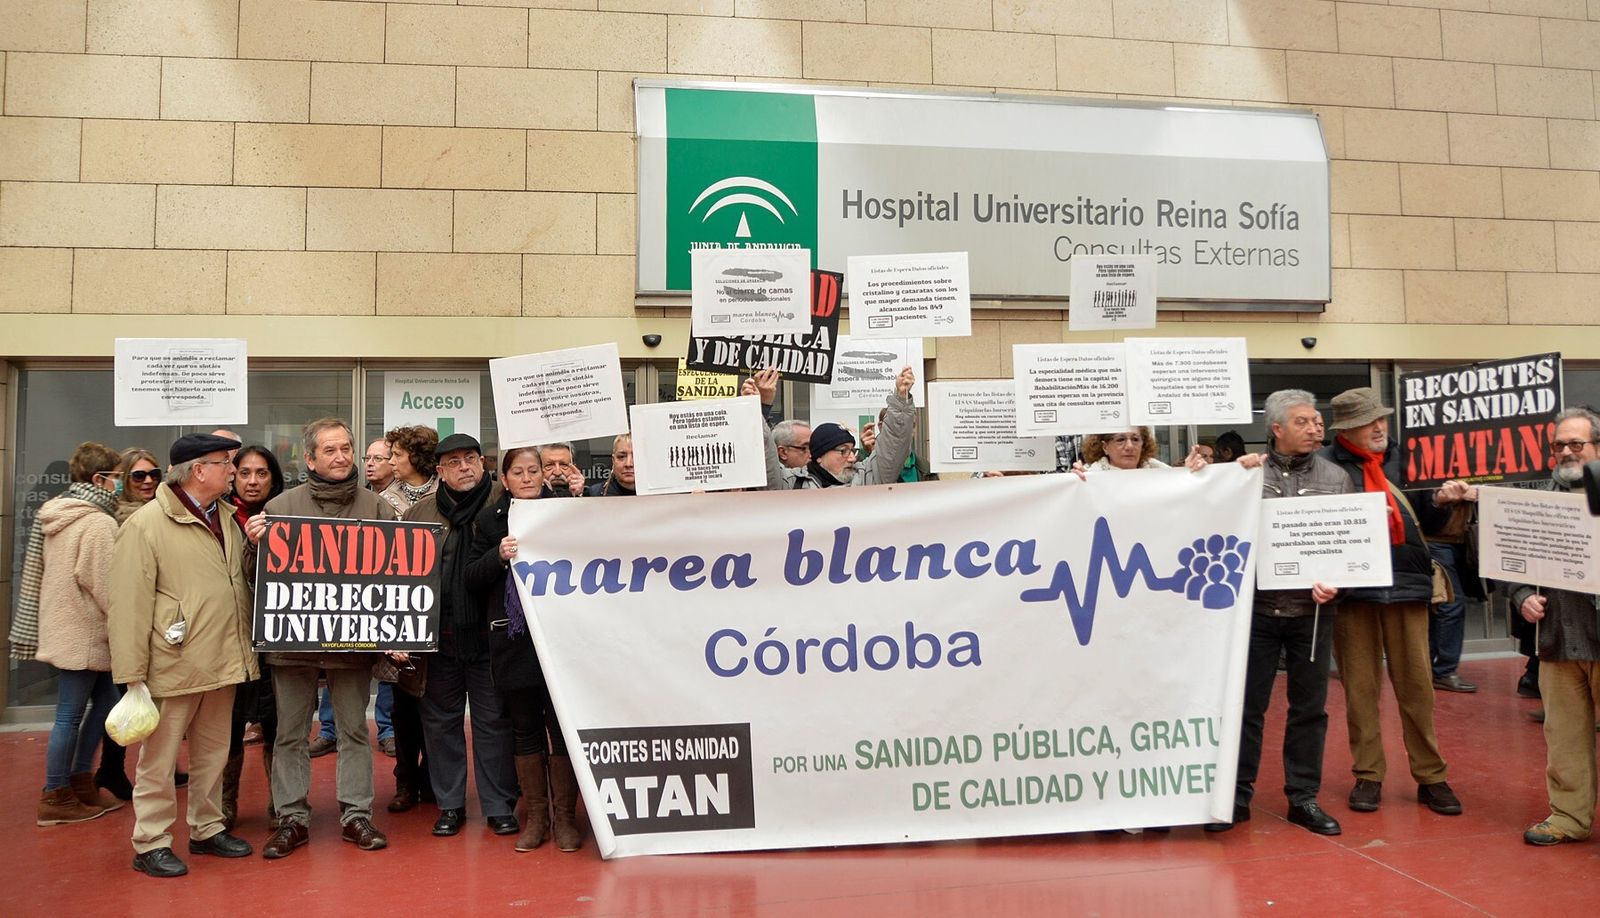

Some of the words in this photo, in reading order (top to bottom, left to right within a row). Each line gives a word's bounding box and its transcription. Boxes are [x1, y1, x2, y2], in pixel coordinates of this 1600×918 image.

[843, 190, 959, 229] Hospital
[974, 194, 1144, 227] Universitario
[1156, 199, 1228, 229] Reina
[1235, 201, 1299, 231] Sofía
[1054, 236, 1181, 264] Consultas
[1195, 240, 1300, 267] Externas
[880, 279, 932, 288] procedimientos
[695, 338, 709, 363] Y
[713, 341, 741, 367] DE
[745, 344, 829, 376] CALIDAD
[677, 386, 735, 397] SANIDAD
[1406, 359, 1554, 402] RECORTES
[400, 391, 464, 409] Acceso
[1405, 403, 1436, 428] EN
[1442, 388, 1556, 424] SANIDAD
[1408, 422, 1557, 482] ¡MATAN!
[1271, 539, 1315, 548] aguardaban
[1280, 521, 1307, 530] pasado
[267, 522, 436, 576] SANIDAD
[514, 556, 756, 597] marea
[786, 527, 1042, 588] blanca
[1299, 548, 1342, 556] especialista
[265, 582, 434, 612] DERECHO
[264, 614, 433, 642] UNIVERSAL
[706, 621, 982, 678] Córdoba
[652, 739, 671, 762] EN
[675, 736, 739, 761] SANIDAD
[773, 756, 807, 774] POR
[813, 754, 847, 772] UNA
[854, 735, 982, 770] SANIDAD
[992, 722, 1121, 761] PÚBLICA,
[599, 773, 730, 820] ATAN
[913, 780, 951, 812] DE
[960, 772, 1084, 808] CALIDAD
[1092, 770, 1108, 800] Y
